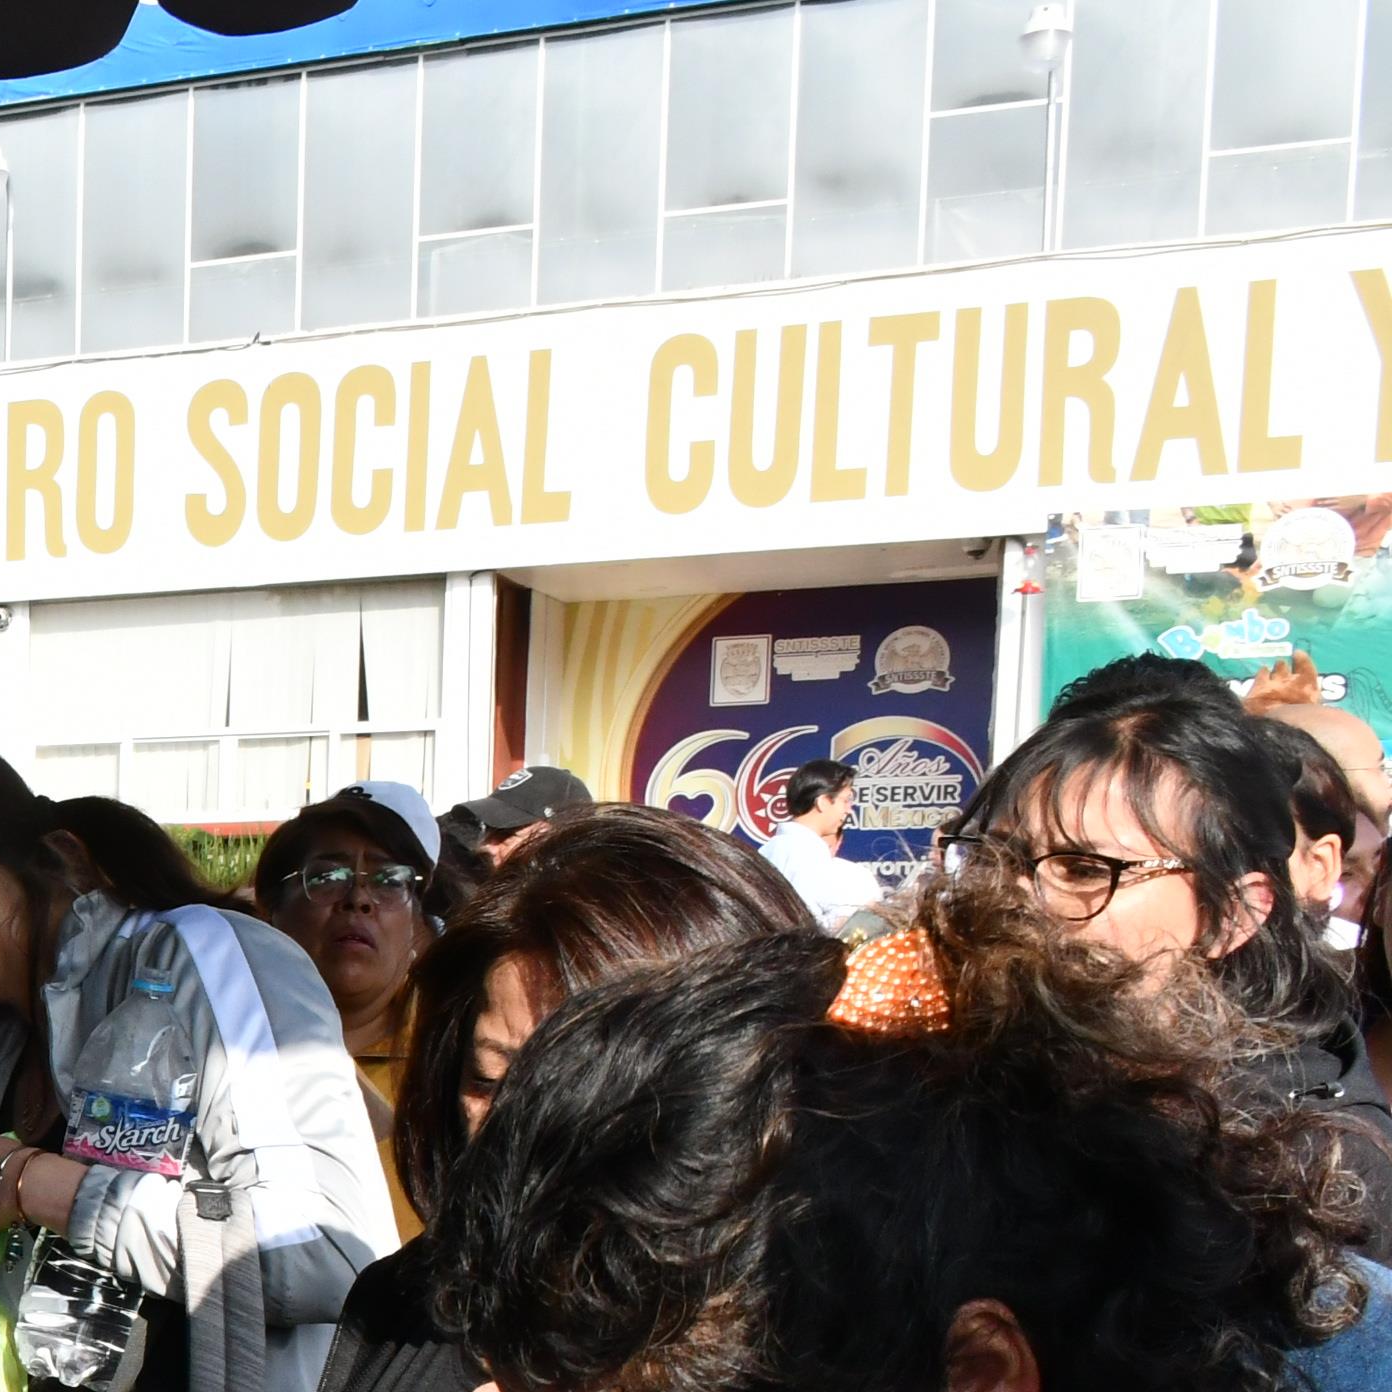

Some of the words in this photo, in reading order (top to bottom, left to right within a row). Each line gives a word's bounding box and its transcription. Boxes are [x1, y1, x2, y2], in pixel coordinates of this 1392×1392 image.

[186, 350, 570, 546] SOCIAL
[646, 280, 1302, 514] CULTURAL
[1271, 561, 1339, 580] SNTISSSTE
[775, 636, 859, 652] SNTISSSTE
[883, 670, 939, 684] SNTISSSTE
[857, 737, 951, 777] Años
[875, 784, 958, 803] SERVIR
